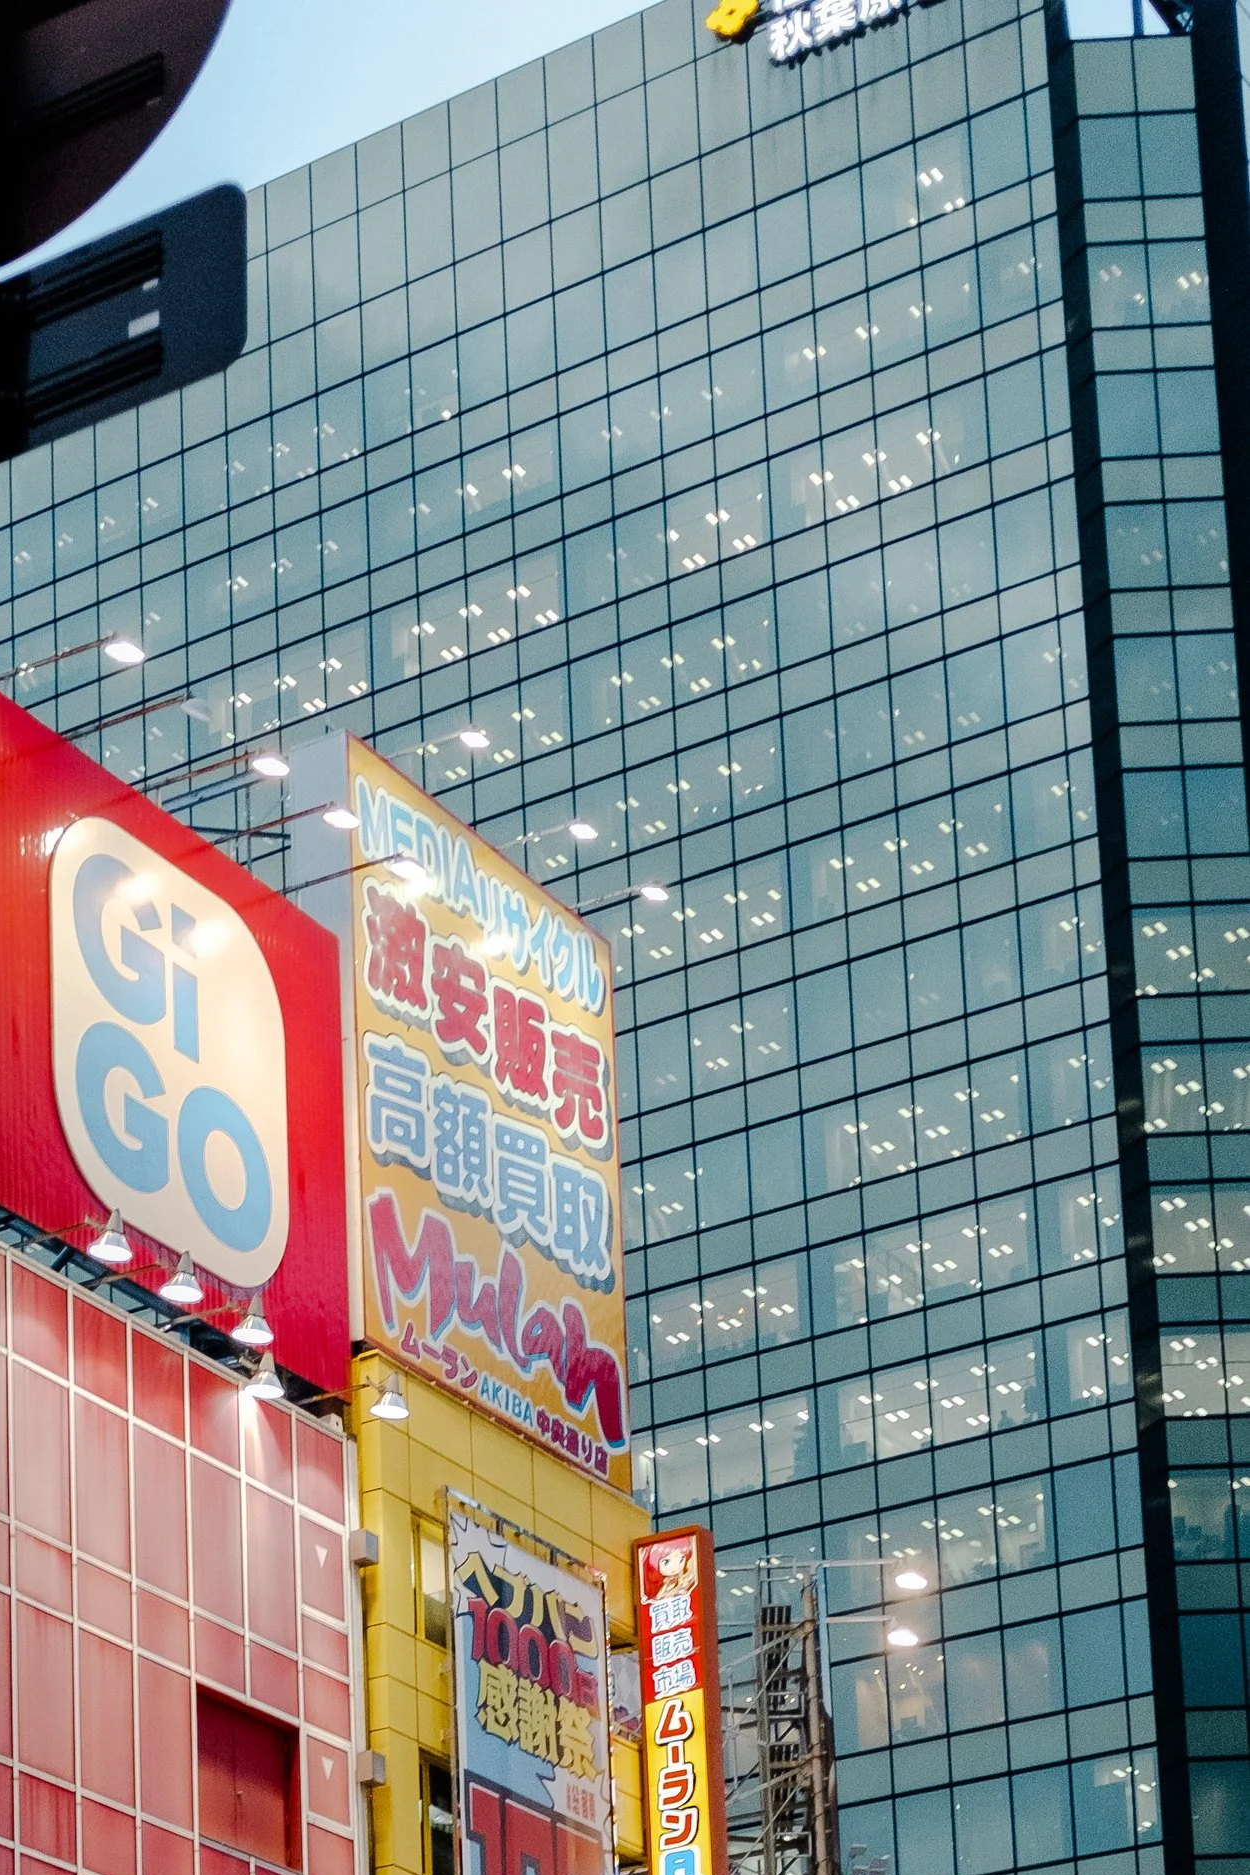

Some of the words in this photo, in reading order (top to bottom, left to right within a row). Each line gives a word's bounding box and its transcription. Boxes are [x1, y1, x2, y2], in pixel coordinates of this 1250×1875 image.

[362, 877, 611, 1149] 激安販売
[363, 1033, 613, 1283] 高額買取
[367, 1190, 629, 1454] Mulan
[651, 1597, 691, 1632] 買取
[652, 1629, 695, 1665] 販売
[653, 1661, 696, 1696] 市場
